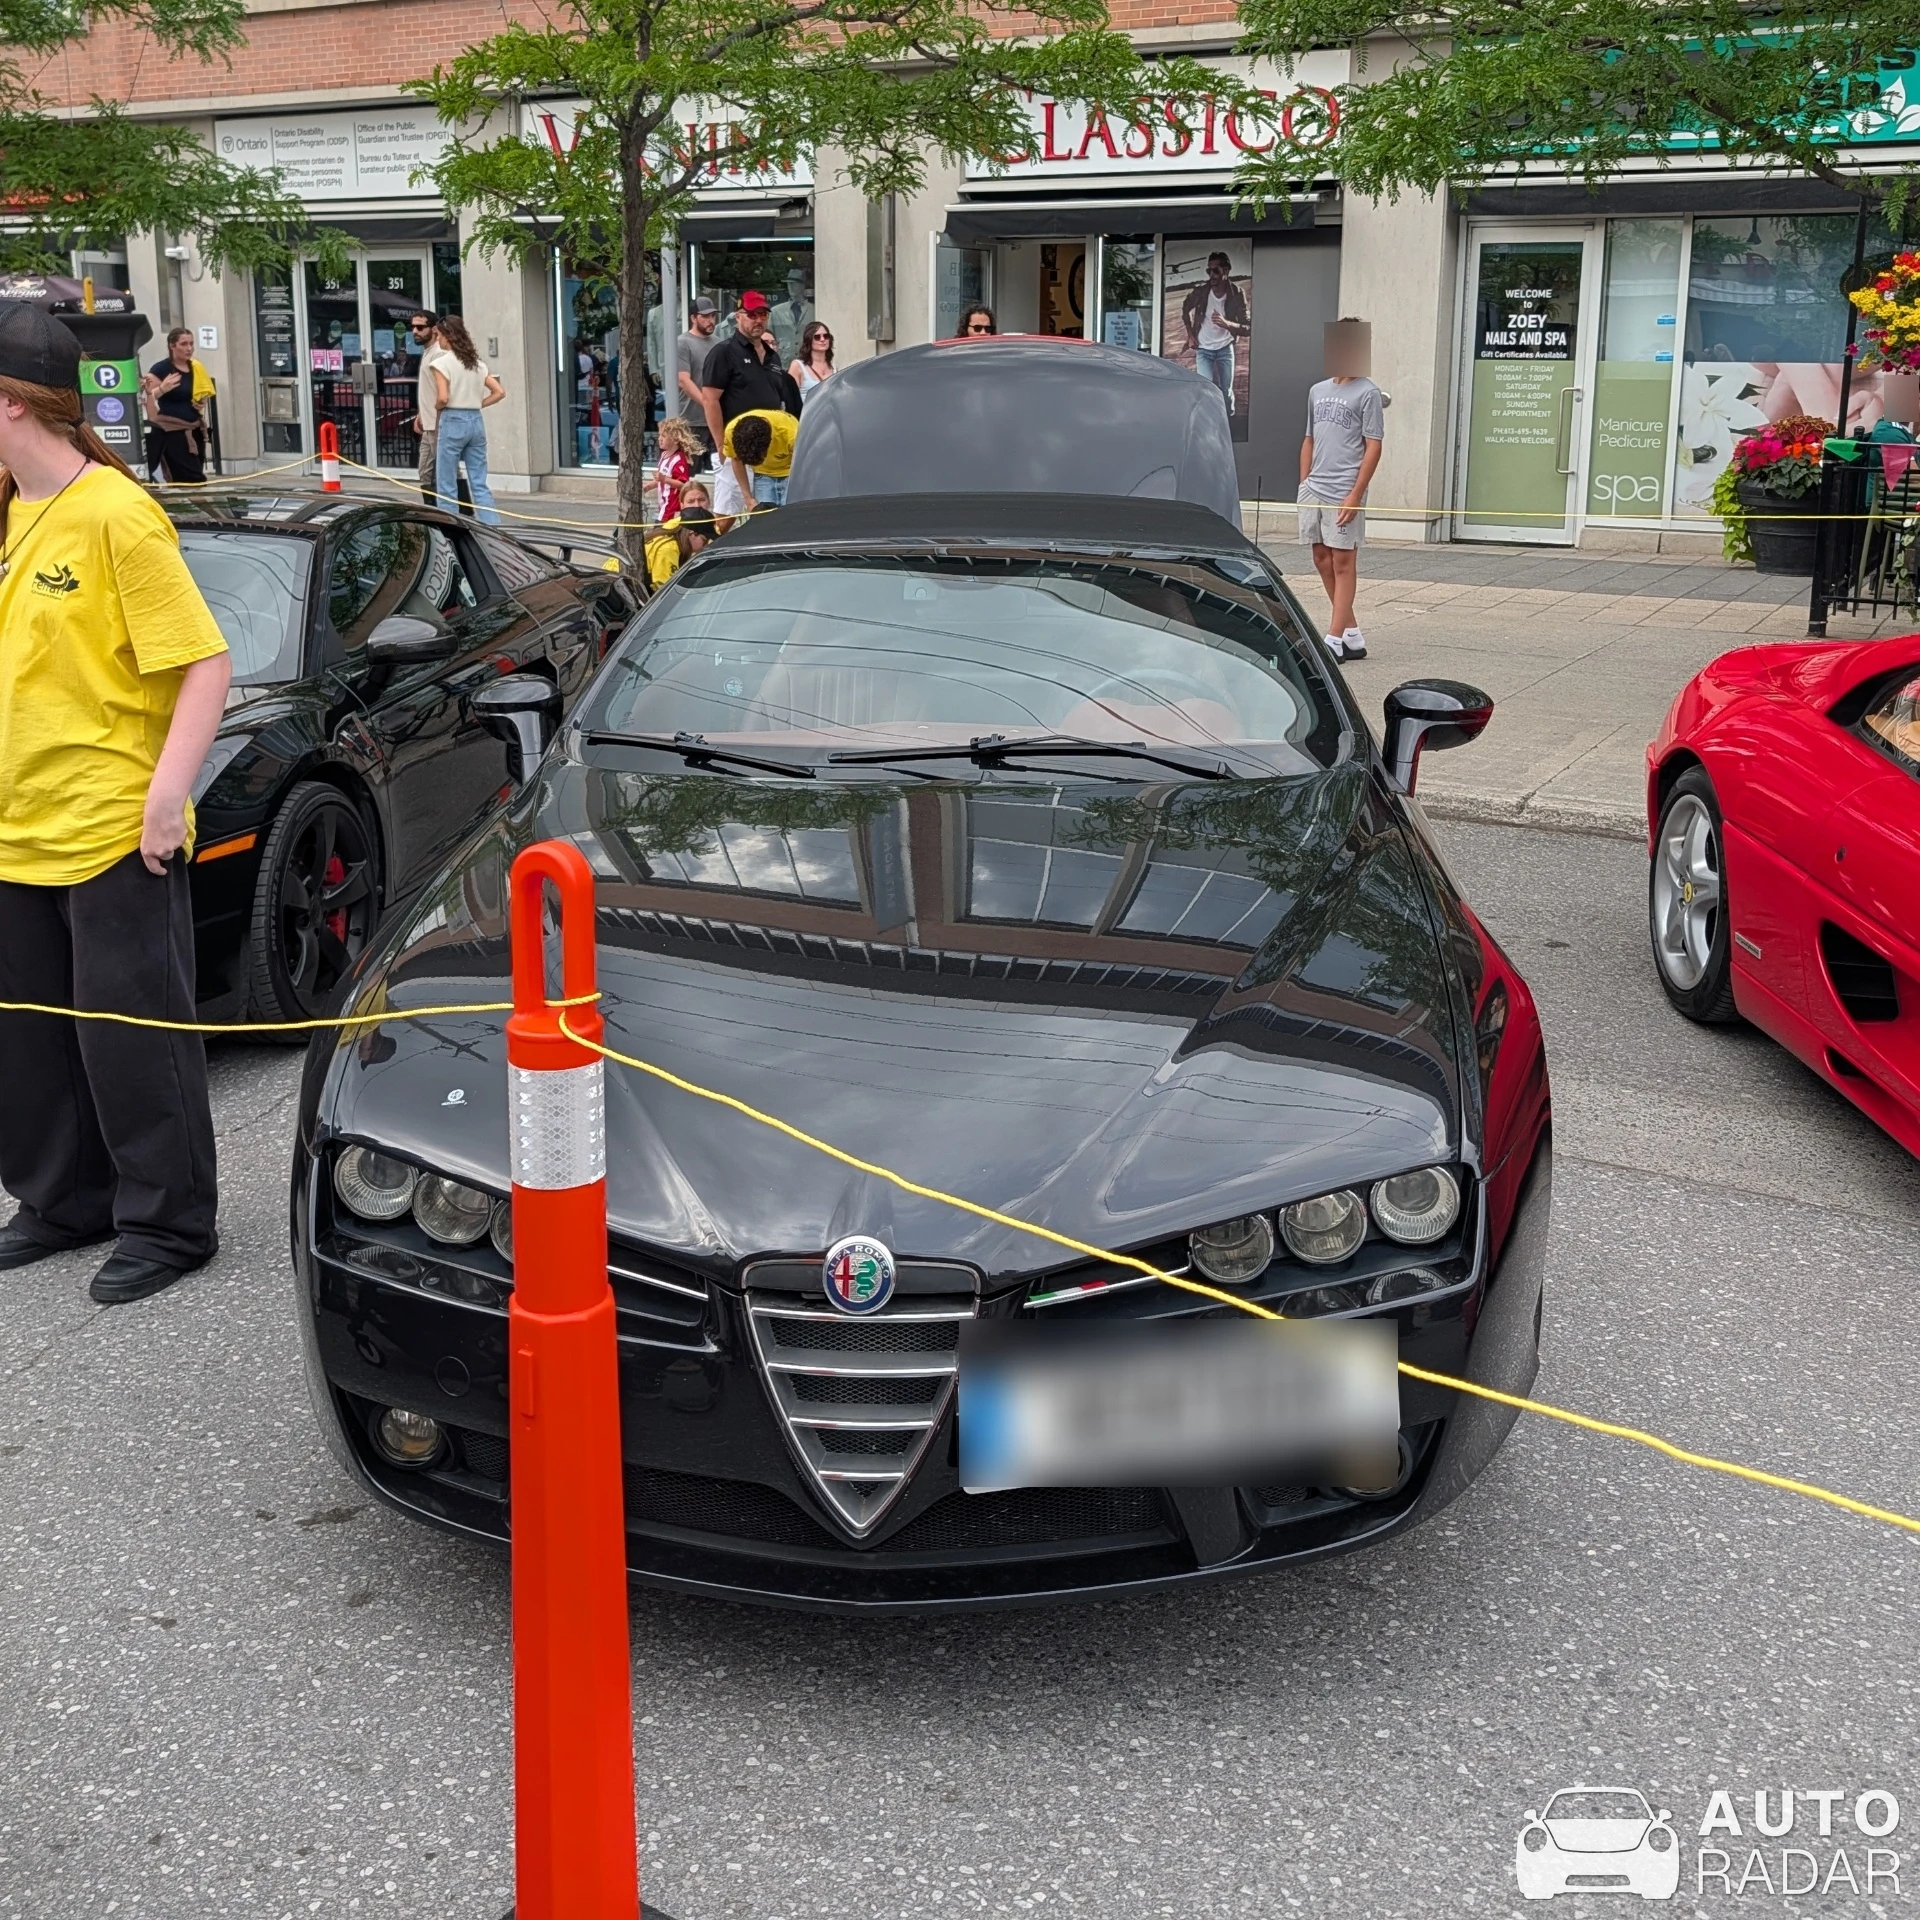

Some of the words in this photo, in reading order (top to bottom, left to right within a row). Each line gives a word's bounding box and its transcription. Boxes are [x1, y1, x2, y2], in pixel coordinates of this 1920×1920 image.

[274, 128, 296, 138] Ontario
[297, 127, 325, 137] Disability
[357, 123, 375, 133] Office
[377, 123, 384, 132] of
[385, 122, 394, 131] the
[396, 121, 416, 131] Public
[275, 141, 298, 149] Support
[300, 139, 325, 149] Program
[327, 136, 350, 147] (ODSP)
[358, 135, 387, 144] Guardian
[387, 133, 400, 142] and
[401, 132, 424, 142] Trustee
[425, 131, 450, 142] (OPGT)
[236, 138, 268, 151] Ontario
[276, 158, 310, 167] Programme
[311, 157, 335, 165] ontarien
[337, 156, 345, 164] de
[359, 154, 382, 163] Bureau
[382, 153, 391, 161] du
[393, 152, 412, 161] Tuteur
[413, 152, 420, 160] et
[311, 168, 343, 177] personnes
[360, 165, 386, 174] curateur
[386, 163, 406, 174] public
[279, 179, 314, 189] andicapées
[316, 178, 343, 189] (POSPH)
[325, 278, 340, 290] 351
[388, 277, 404, 290] 351
[1505, 289, 1553, 299] WELCOME
[1523, 301, 1533, 309] to
[1507, 314, 1547, 328] ZOEY
[1485, 331, 1517, 346] NAILS
[1519, 332, 1542, 346] AND
[1544, 332, 1567, 346] SPA
[1481, 350, 1493, 358] Gift
[1494, 350, 1534, 359] Certificates
[1535, 350, 1568, 359] Available
[1530, 365, 1555, 373] FRIDAY
[1528, 374, 1553, 382] 7:00PM
[1527, 392, 1551, 400] 6:00PM
[1506, 401, 1538, 409] SUNDAYS
[1313, 401, 1352, 430] AGLES
[1502, 410, 1552, 418] APPOINTMENT
[1599, 418, 1663, 433] Manicure
[1484, 436, 1519, 444] WALK-INS
[1520, 437, 1555, 445] WELCOME
[1599, 434, 1661, 449] Pedicure
[1593, 474, 1660, 516] spa
[828, 1248, 851, 1278] ALFA
[855, 1245, 890, 1279] ROMEO
